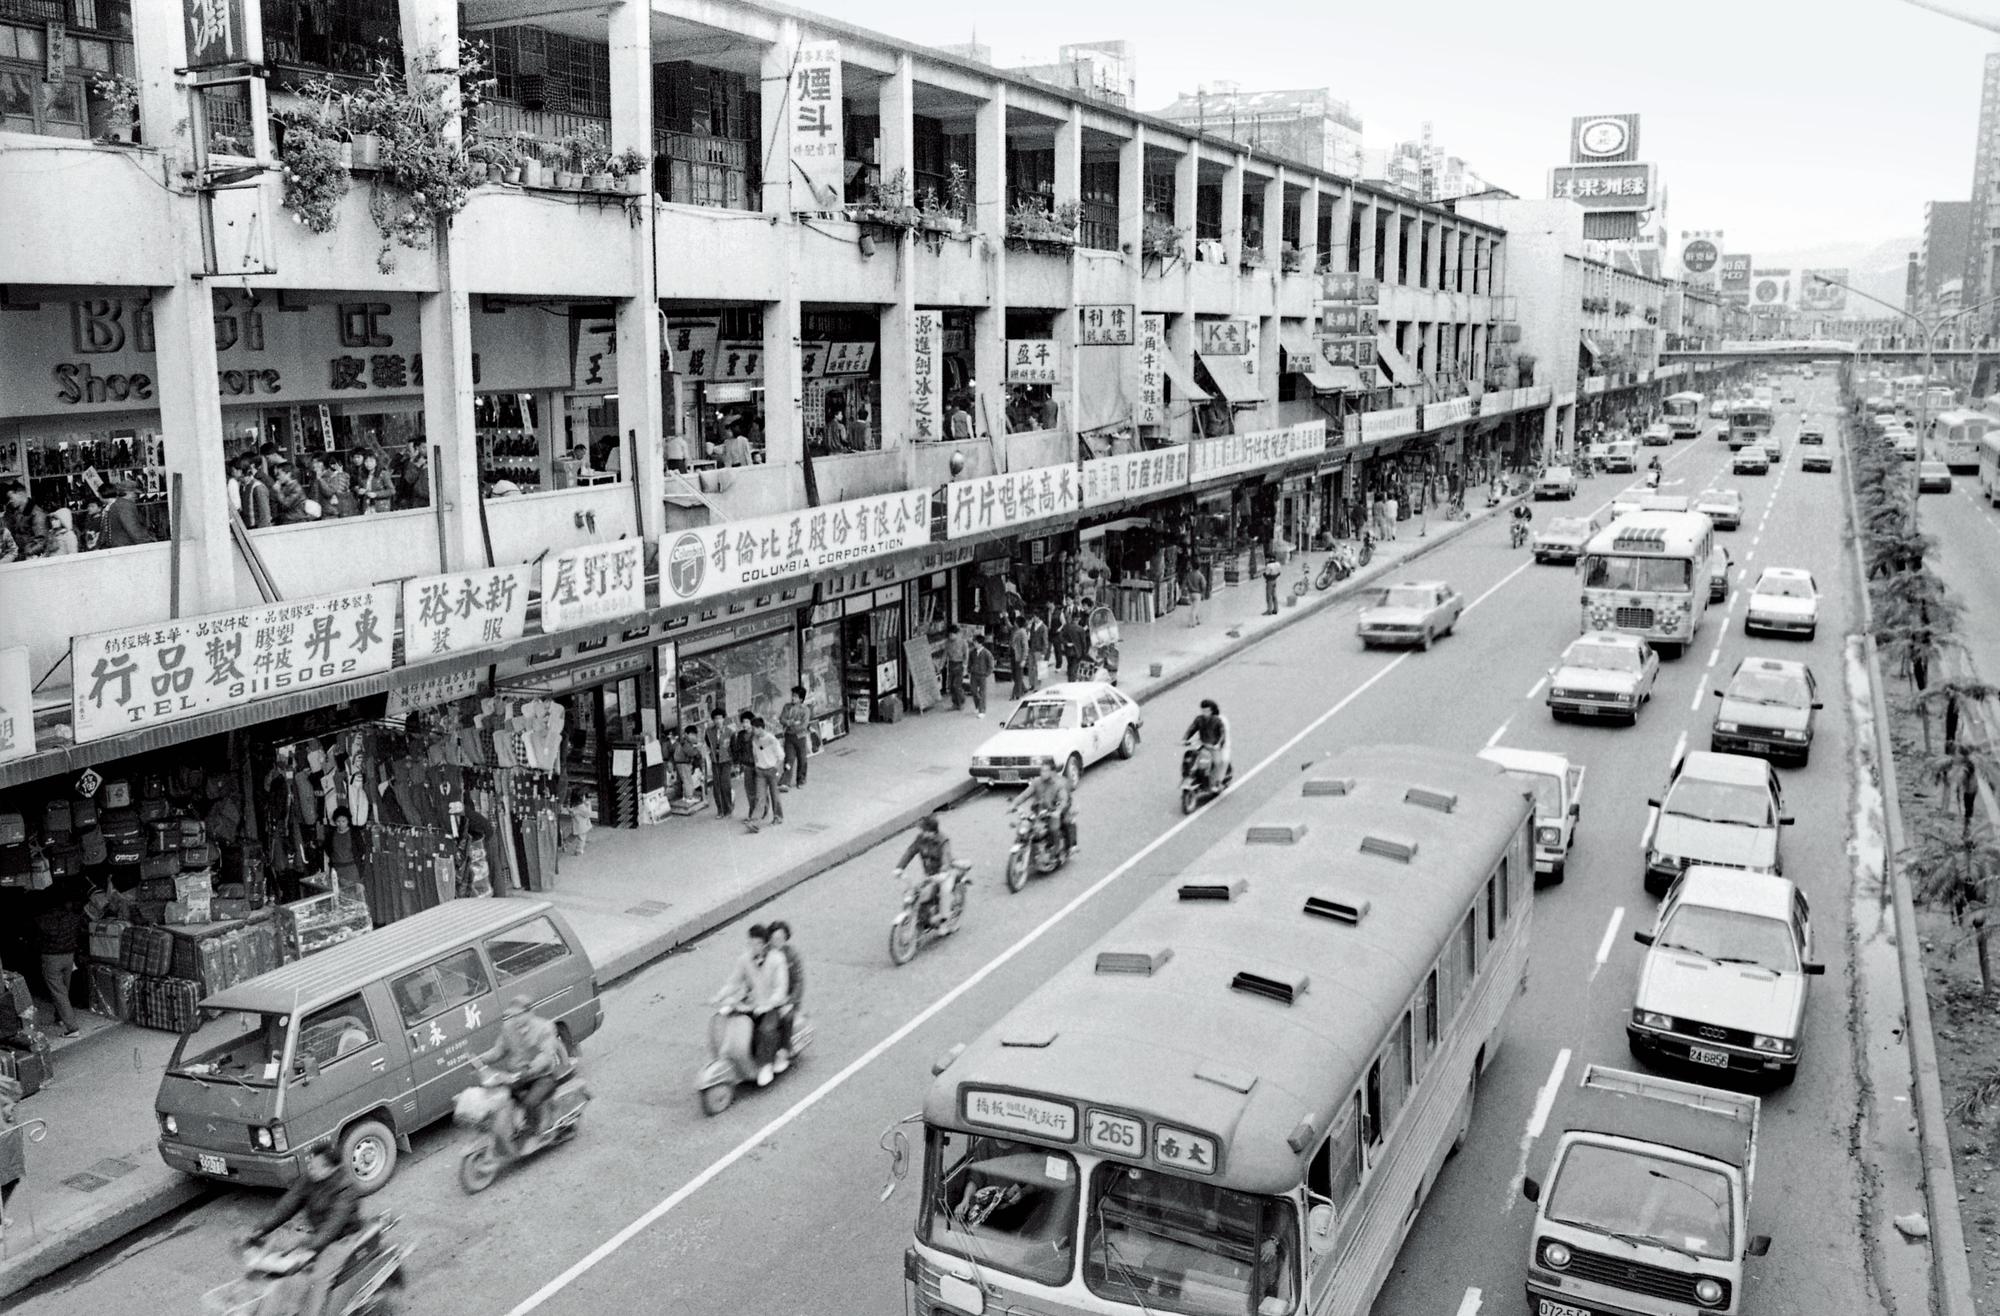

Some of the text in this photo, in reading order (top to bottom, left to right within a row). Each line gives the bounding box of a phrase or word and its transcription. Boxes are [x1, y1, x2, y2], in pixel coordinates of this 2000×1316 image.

[797, 67, 832, 137] 煙斗
[55, 362, 281, 404] Shoe ore
[1143, 318, 1157, 422] 獨角牛皮鞋店
[711, 493, 927, 573] 哥倫比亞股份有限公司
[742, 538, 904, 583] COLUMBIA CORPORATION
[418, 574, 518, 628] 新永裕
[228, 658, 357, 698] 3115062
[1097, 1120, 1134, 1148] 265
